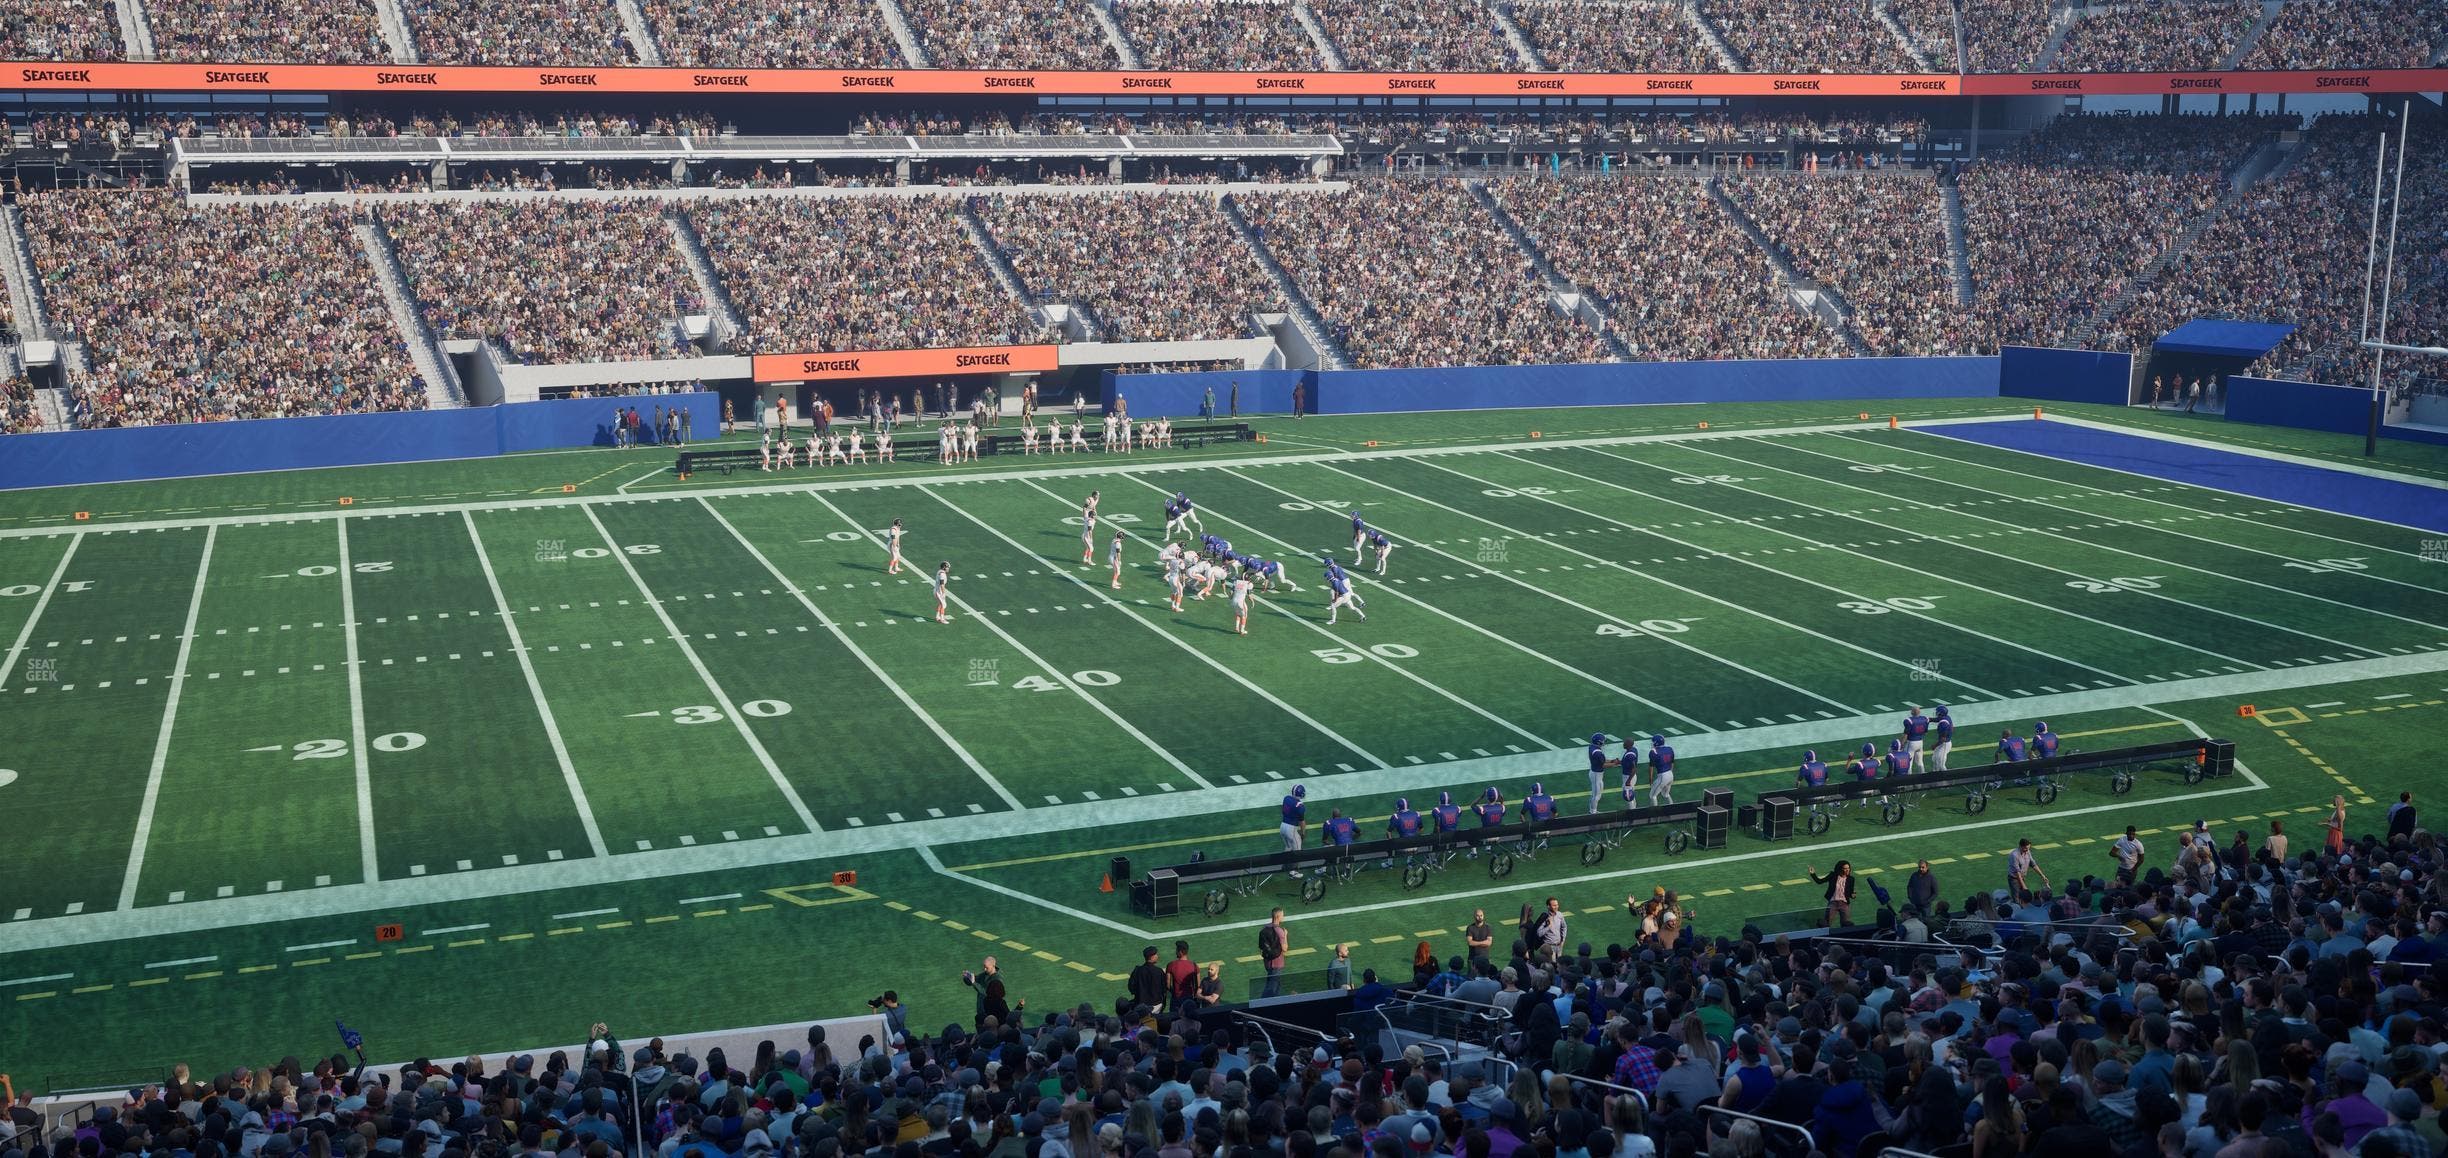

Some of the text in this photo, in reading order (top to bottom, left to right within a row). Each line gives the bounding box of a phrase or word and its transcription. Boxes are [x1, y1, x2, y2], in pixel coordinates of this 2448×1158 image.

[23, 70, 90, 82] SEATGEEK
[206, 71, 269, 83] SEATGEEK
[378, 73, 437, 84] SEATGEEK
[540, 74, 597, 85] SEATGEEK
[694, 75, 748, 86] SEATGEEK
[843, 76, 894, 87] SEATGEEK
[985, 77, 1034, 87] SEATGEEK
[1123, 78, 1171, 88] SEATGEEK
[1257, 79, 1304, 88] SEATGEEK
[1389, 79, 1435, 89] SEATGEEK
[1518, 80, 1564, 89] SEATGEEK
[1647, 80, 1692, 89] SEATGEEK
[1774, 80, 1819, 90] SEATGEEK
[1901, 81, 1945, 90] SEATGEEK
[2032, 80, 2081, 89] SEATGEEK
[2171, 79, 2222, 88] SEATGEEK
[2316, 77, 2369, 87] SEATGEEK
[957, 353, 1010, 367] SEATGEEK
[804, 359, 860, 374] SEATGEEK
[2284, 558, 2370, 573] 10
[2065, 576, 2163, 594] 20
[1836, 597, 1937, 616] 30
[1595, 619, 1690, 638] 40
[1310, 643, 1420, 664] 50
[1012, 670, 1122, 692] 40
[671, 699, 793, 724] 30
[293, 731, 427, 760] 20
[839, 872, 851, 883] 30
[383, 926, 396, 938] 20
